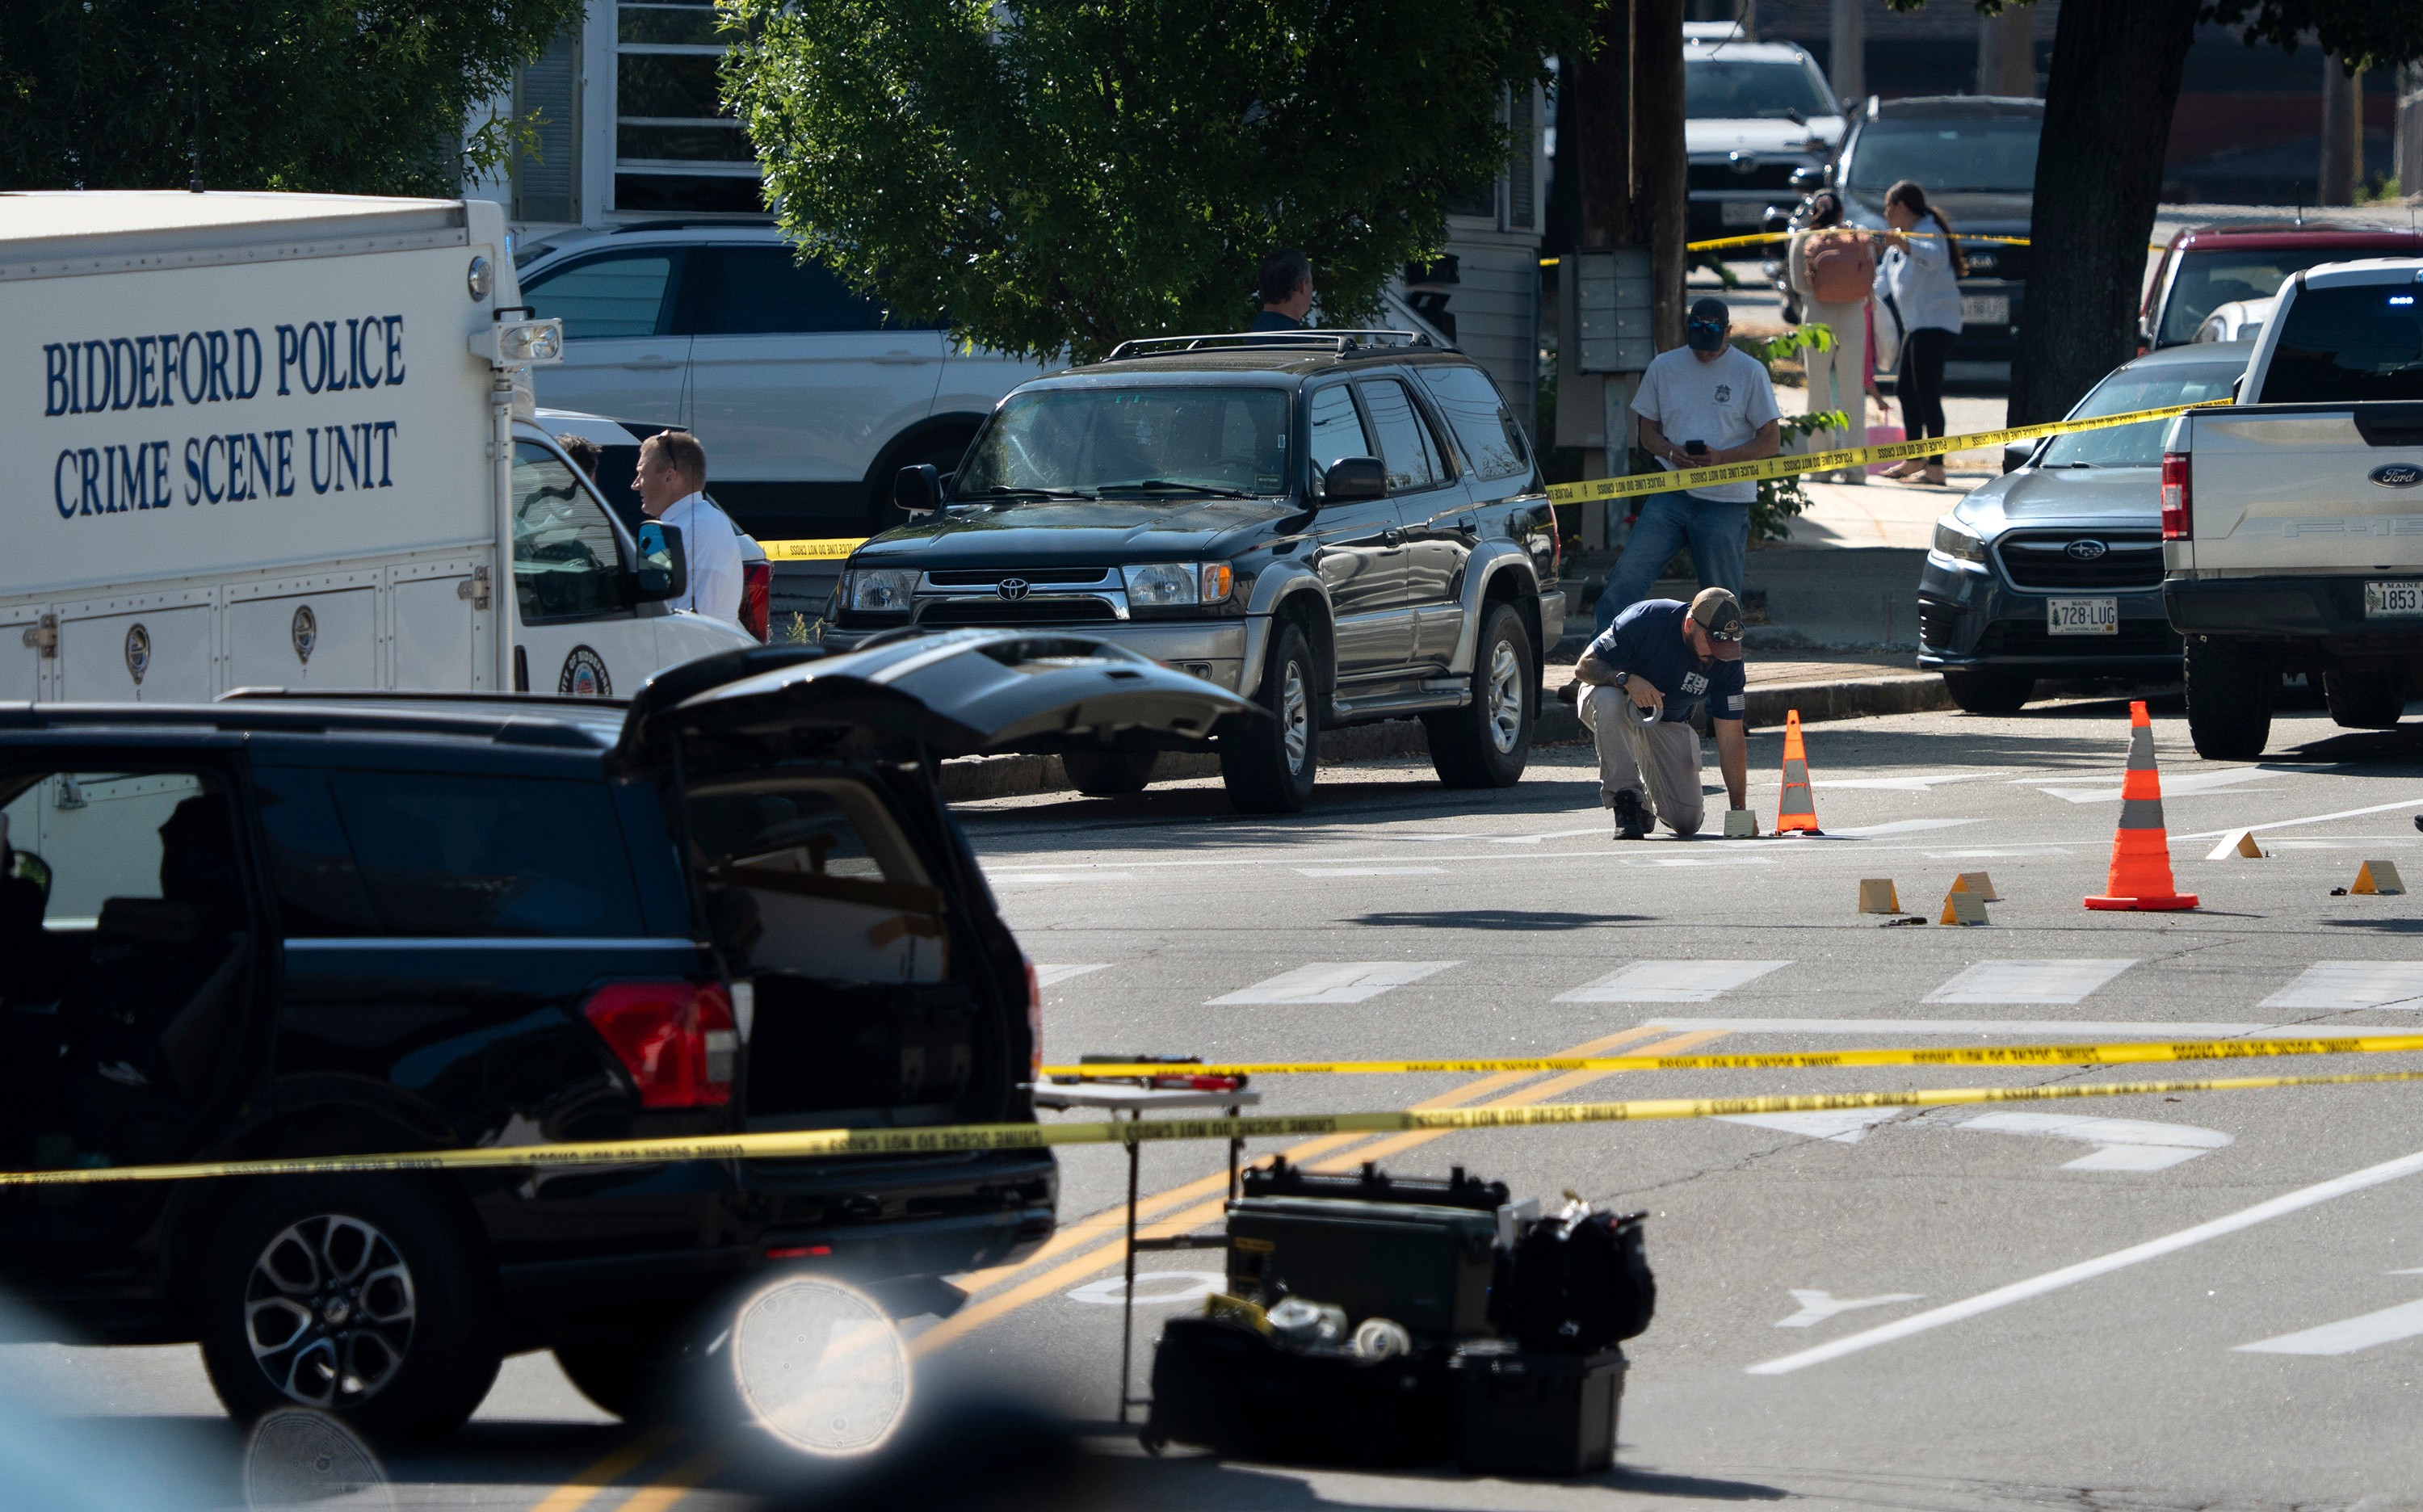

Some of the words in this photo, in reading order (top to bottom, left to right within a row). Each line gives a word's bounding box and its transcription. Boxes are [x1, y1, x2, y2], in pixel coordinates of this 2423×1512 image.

[44, 327, 262, 417] BIDDEFORD
[275, 314, 405, 397] POLICE
[2067, 422, 2084, 432] CROSS
[2085, 421, 2096, 430] NOT
[1991, 434, 2001, 443] NOT
[2003, 432, 2009, 442] DO
[2010, 430, 2021, 441] LINE
[2022, 428, 2042, 439] POLICE
[1929, 440, 1947, 452] POLICE
[1972, 436, 1989, 446] CROSS
[1878, 447, 1895, 459] CROSS
[1896, 445, 1906, 456] NOT
[1907, 443, 1915, 453] DO
[1916, 442, 1928, 453] LINE
[1812, 457, 1820, 467] DO
[1821, 454, 1833, 466] LINE
[1834, 452, 1853, 464] POLICE
[54, 440, 172, 519] CRIME
[184, 429, 294, 507] SCENE
[308, 420, 397, 495] UNIT
[1783, 460, 1800, 472] CROSS
[1802, 459, 1812, 470] NOT
[1708, 470, 1719, 481] NOT
[1720, 469, 1727, 480] DO
[1728, 467, 1740, 478] LINE
[1741, 464, 1759, 477] POLICE
[2383, 468, 2416, 483] Ford
[1646, 477, 1666, 489] POLICE
[1690, 472, 1707, 483] CROSS
[1597, 482, 1615, 494] CROSS
[1615, 482, 1626, 492] NOT
[1627, 480, 1633, 490] DO
[1635, 479, 1645, 489] LINE
[1555, 487, 1573, 499] POLICE
[790, 545, 807, 556] CROSS
[808, 545, 817, 555] NOT
[818, 544, 826, 555] DO
[827, 544, 839, 555] LINE
[2382, 590, 2416, 610] 1853
[1684, 671, 1709, 689] FBI
[136, 689, 141, 701] 6
[1505, 1109, 1524, 1125] DO
[1531, 1107, 1575, 1124] SCENE
[1581, 1105, 1627, 1121] CRIME
[1472, 1111, 1498, 1128] NOT
